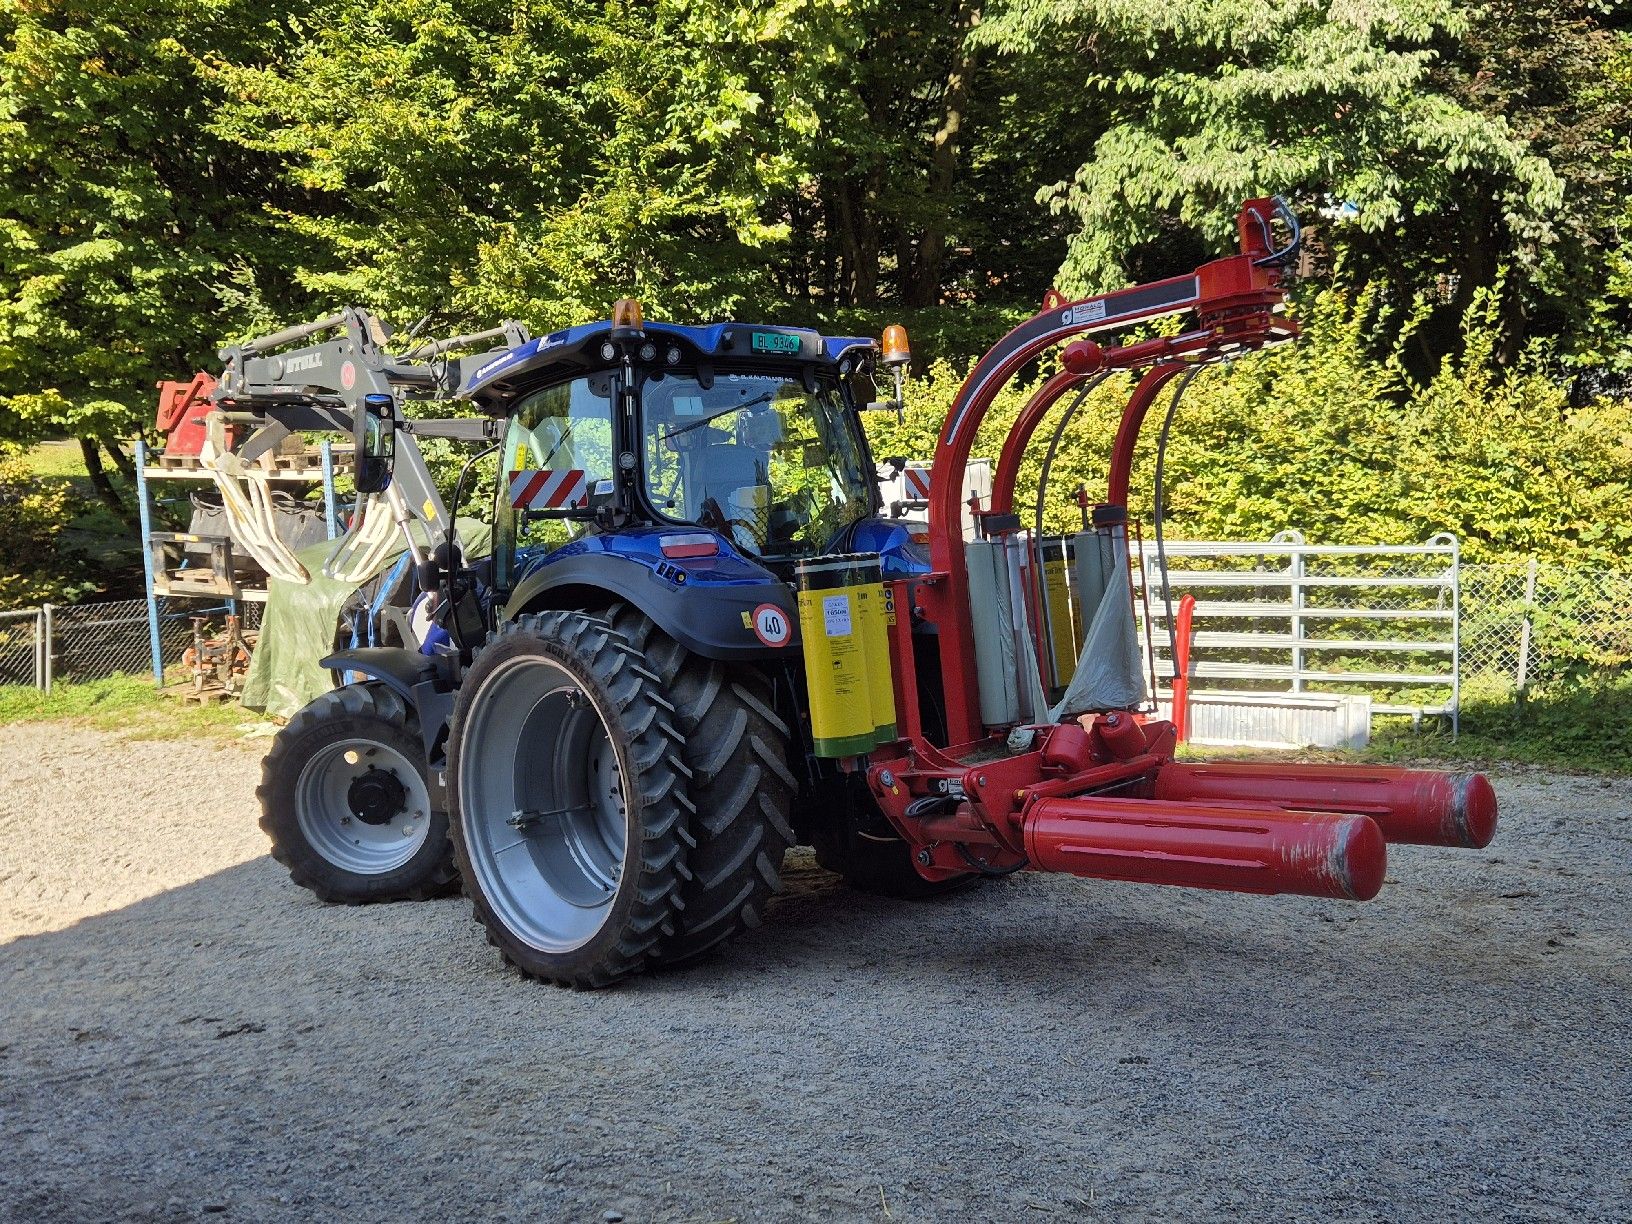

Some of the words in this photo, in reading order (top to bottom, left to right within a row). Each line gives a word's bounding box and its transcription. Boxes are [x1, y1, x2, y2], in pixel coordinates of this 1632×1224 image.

[758, 335, 769, 348] BL
[773, 336, 795, 350] 9346
[765, 616, 781, 635] 40
